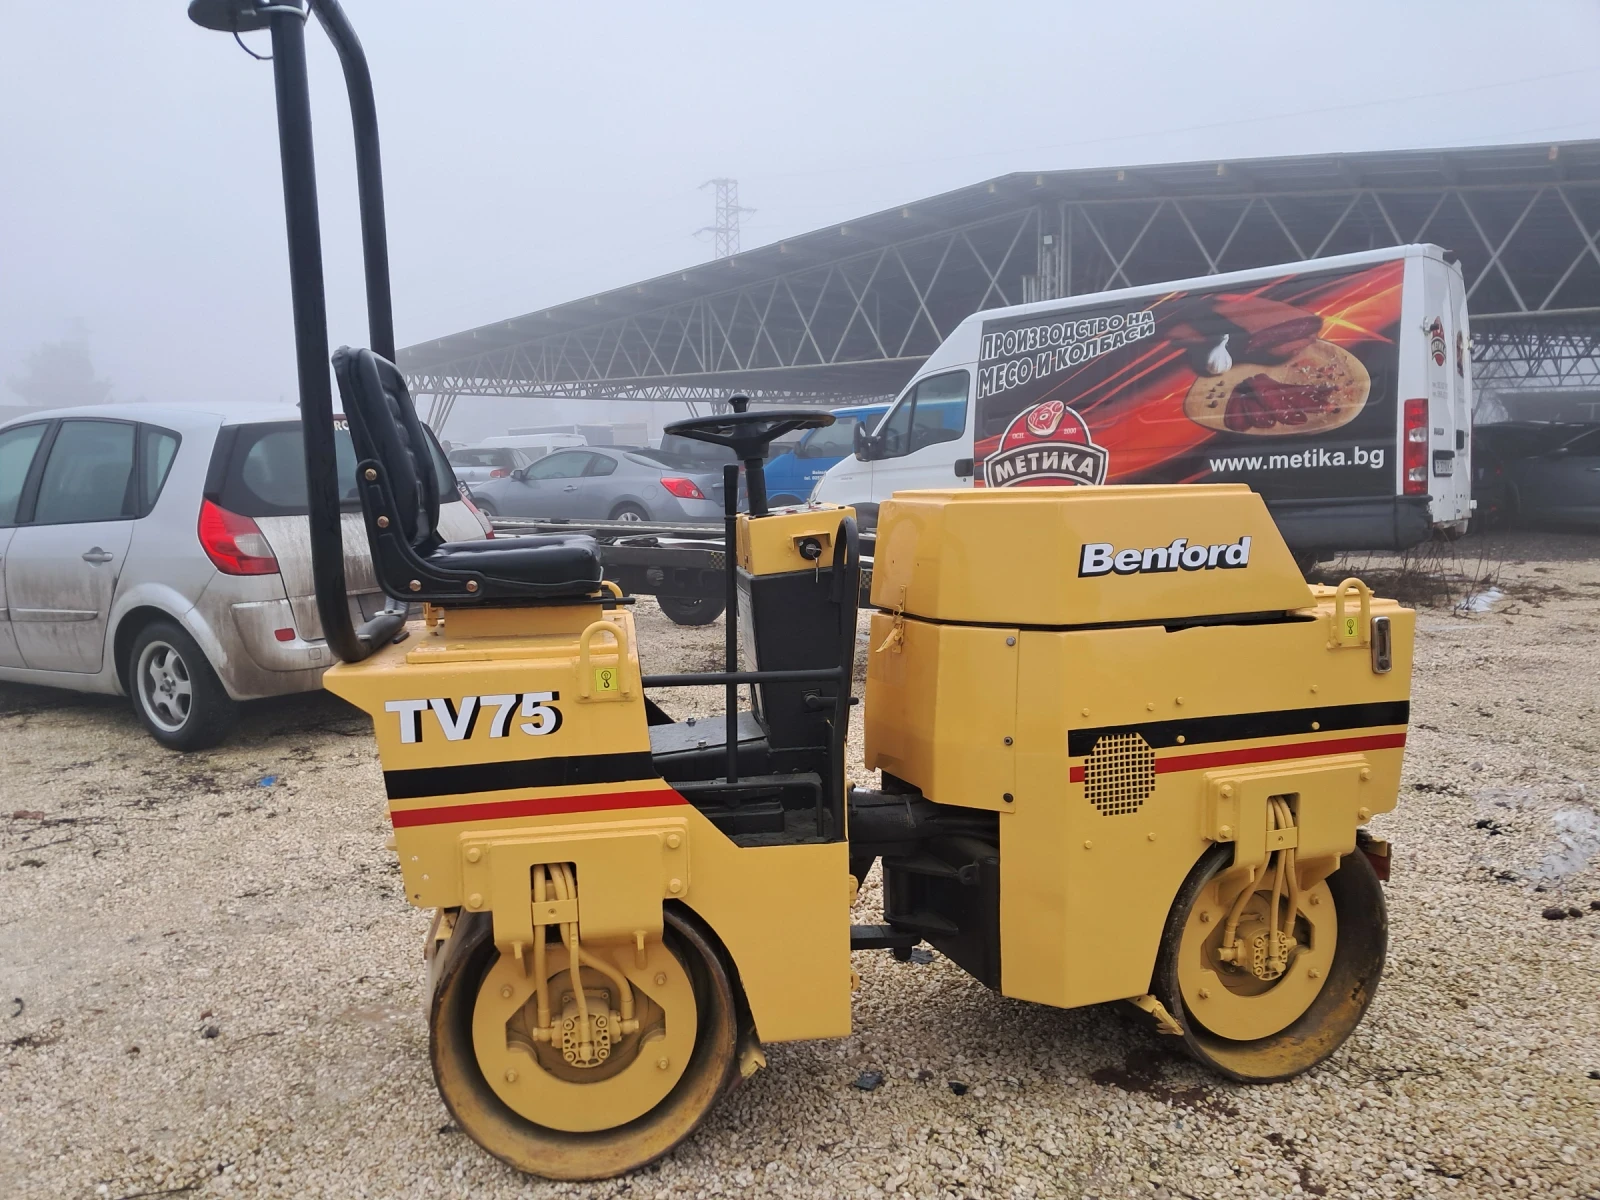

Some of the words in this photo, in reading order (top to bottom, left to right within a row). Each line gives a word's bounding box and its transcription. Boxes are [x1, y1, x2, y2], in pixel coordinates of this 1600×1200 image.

[980, 315, 1124, 361] ПРОИЗВОДСТВО
[1126, 310, 1154, 327] НА
[977, 358, 1033, 399] МЕСО
[1036, 351, 1052, 378] И
[1055, 322, 1156, 372] КОЛБАСИ
[995, 451, 1094, 483] МЕТИКА
[1209, 446, 1385, 473] www.metika.bg
[1078, 536, 1252, 578] Benford
[384, 691, 563, 743] TV75
